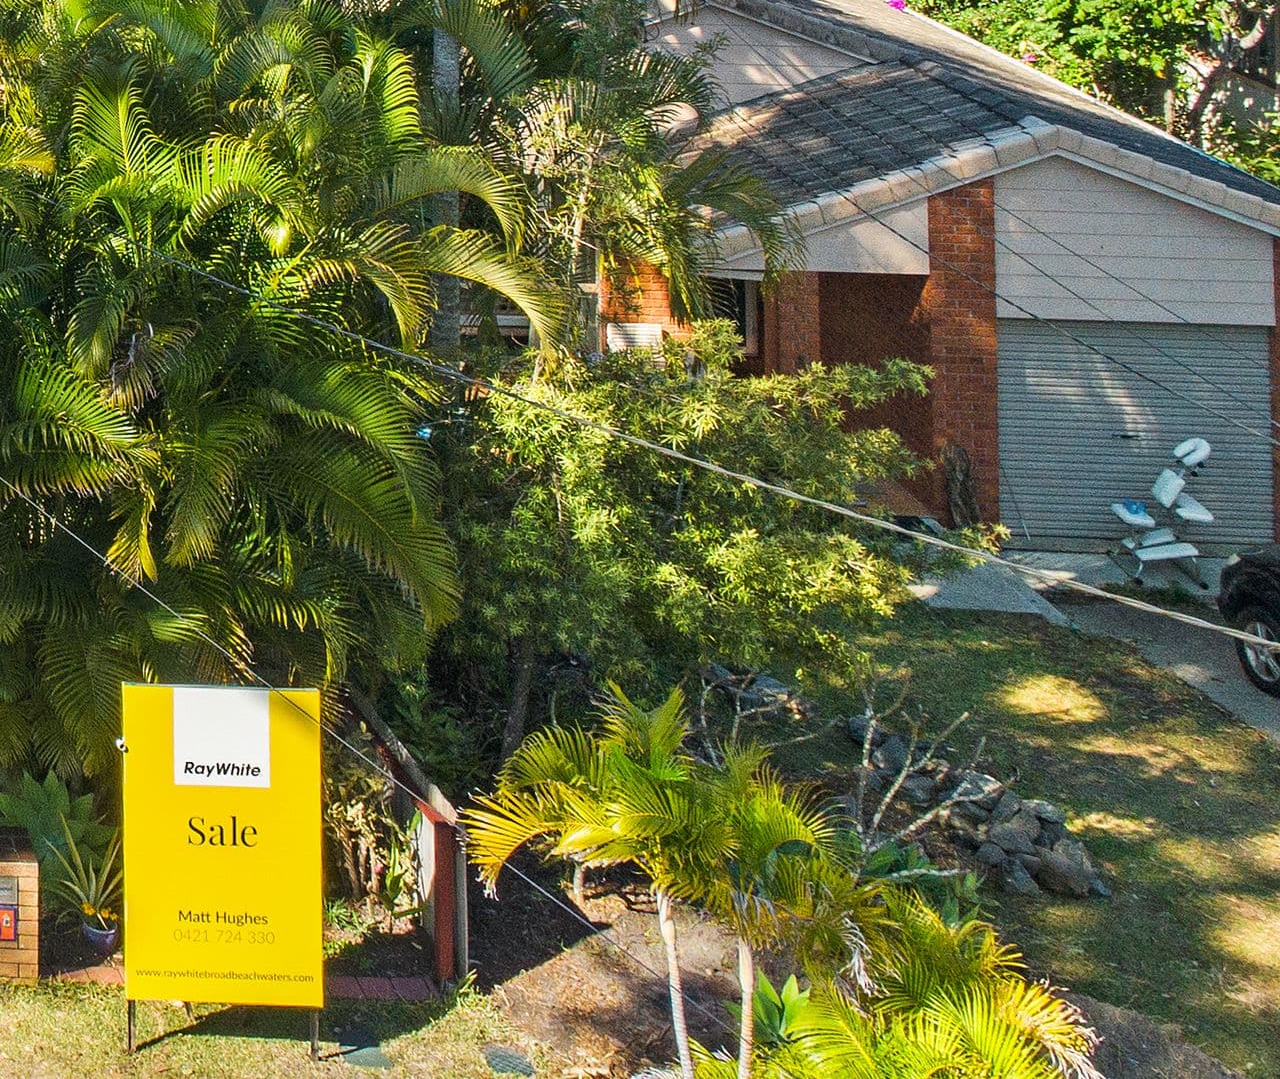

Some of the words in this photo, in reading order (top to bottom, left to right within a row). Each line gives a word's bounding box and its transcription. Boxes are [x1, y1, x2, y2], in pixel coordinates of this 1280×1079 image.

[187, 815, 258, 848] Sale
[178, 910, 211, 923] Matt
[215, 911, 269, 927] Hughes
[173, 928, 209, 943] 0421
[217, 929, 242, 943] 724
[247, 931, 276, 945] 330
[135, 969, 314, 983] www.raywhitebroadbeachwaters.com
